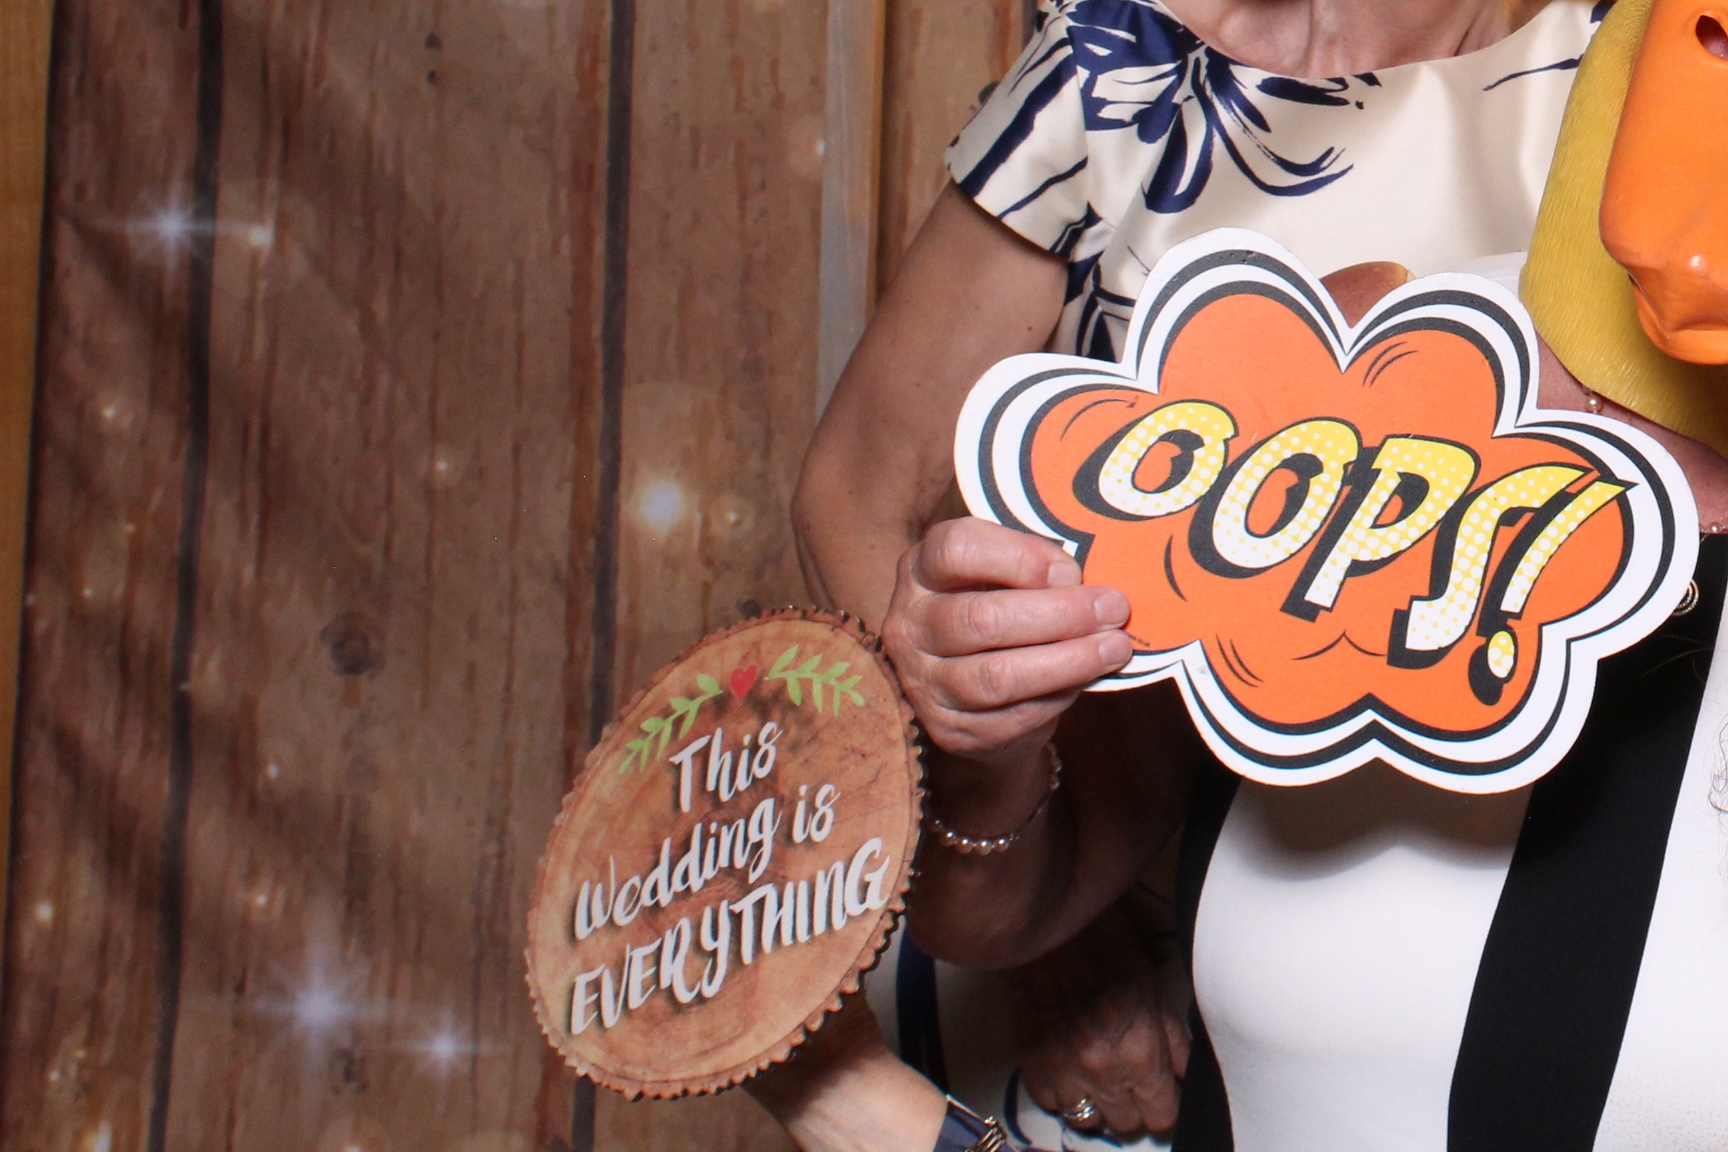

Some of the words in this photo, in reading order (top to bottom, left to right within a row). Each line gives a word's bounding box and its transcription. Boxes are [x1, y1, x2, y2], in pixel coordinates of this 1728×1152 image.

[1072, 399, 1638, 706] OOPS!
[669, 720, 783, 813] This
[570, 835, 891, 1036] EVERYTHING
[573, 796, 783, 941] Wedding
[792, 782, 842, 844] is
